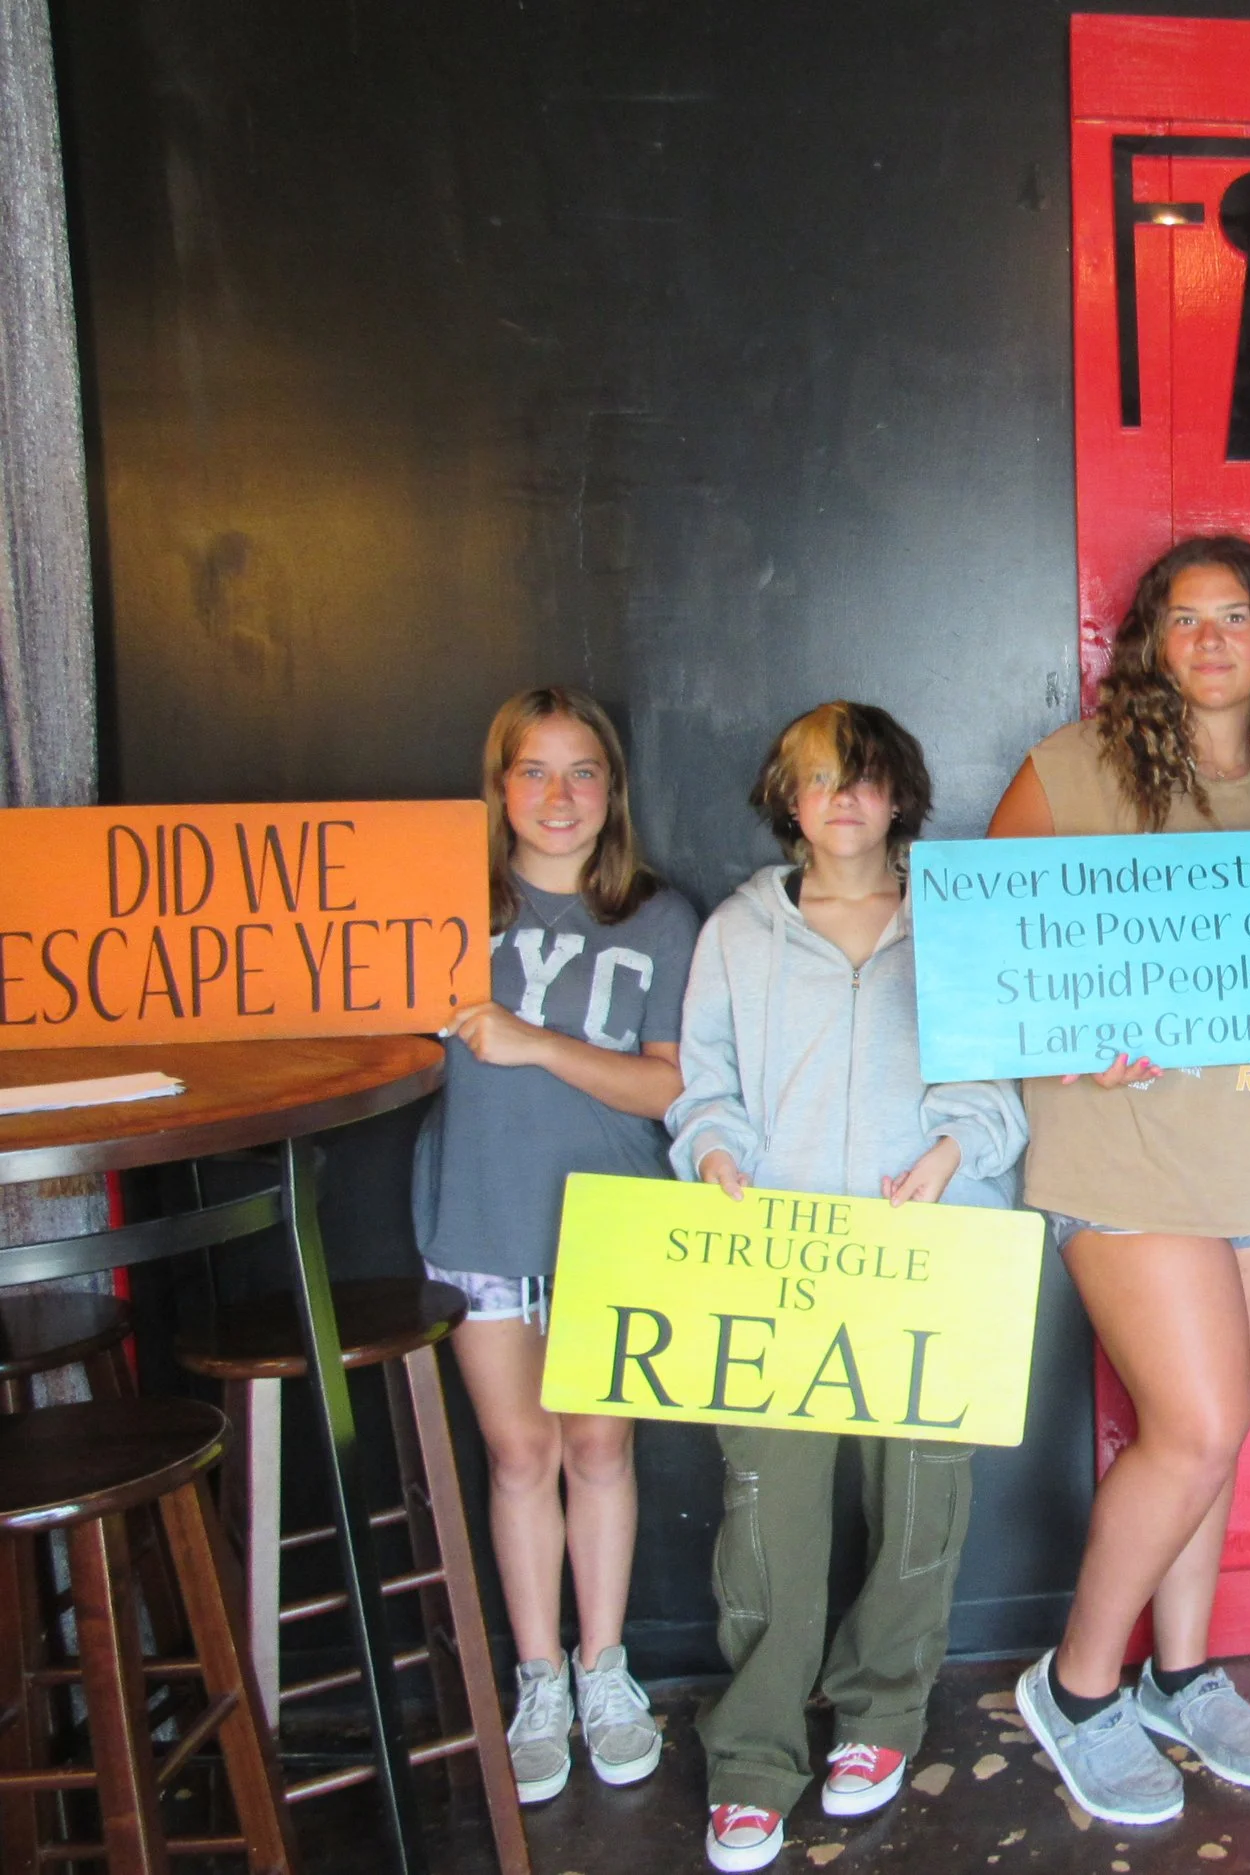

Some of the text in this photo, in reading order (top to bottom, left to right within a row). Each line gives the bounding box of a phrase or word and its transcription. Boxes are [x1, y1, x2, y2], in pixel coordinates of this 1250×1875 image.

[107, 821, 357, 918] DID WE
[923, 867, 1050, 902] Never
[1016, 914, 1086, 950] the
[1096, 911, 1232, 946] Power
[0, 917, 470, 1026] ESCAPE YET?
[492, 928, 654, 1051] YC
[996, 960, 1132, 1010] Stupid
[1018, 1020, 1143, 1061] Large
[759, 1197, 852, 1236] THE
[667, 1228, 930, 1283] STRUGGLE
[776, 1277, 816, 1311] IS
[597, 1305, 969, 1430] REAL
